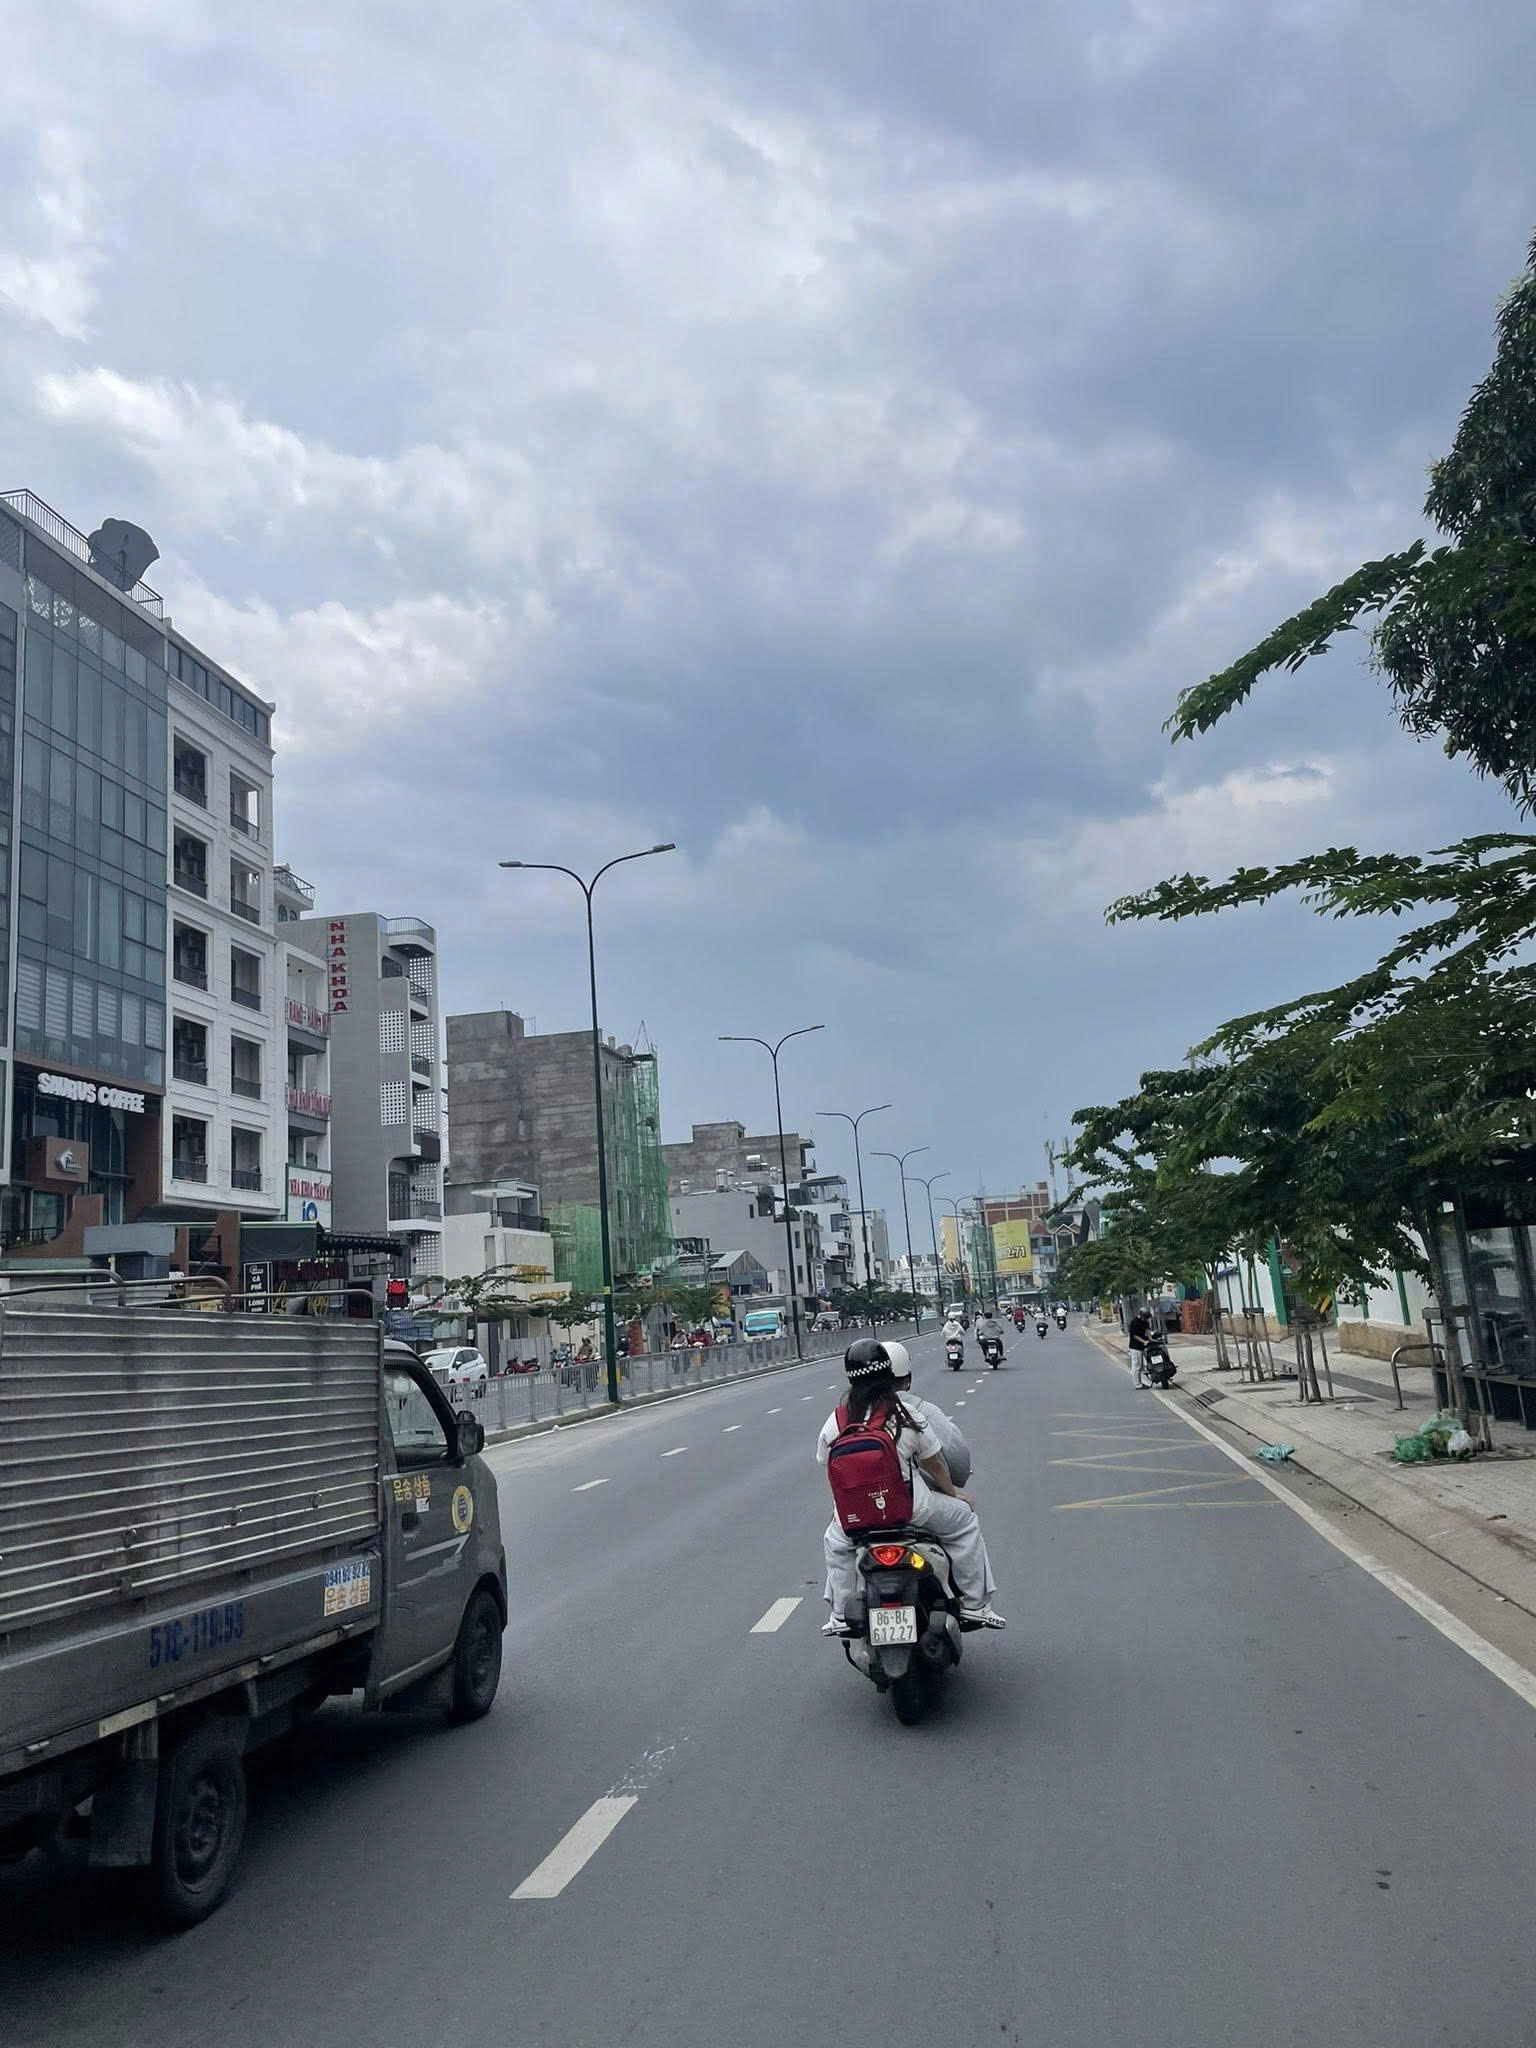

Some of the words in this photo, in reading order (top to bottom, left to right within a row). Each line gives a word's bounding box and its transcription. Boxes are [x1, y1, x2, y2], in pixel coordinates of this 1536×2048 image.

[98, 1086, 145, 1114] COFFEE
[876, 1610, 908, 1626] 86-B4
[873, 1625, 914, 1643] 612.27
